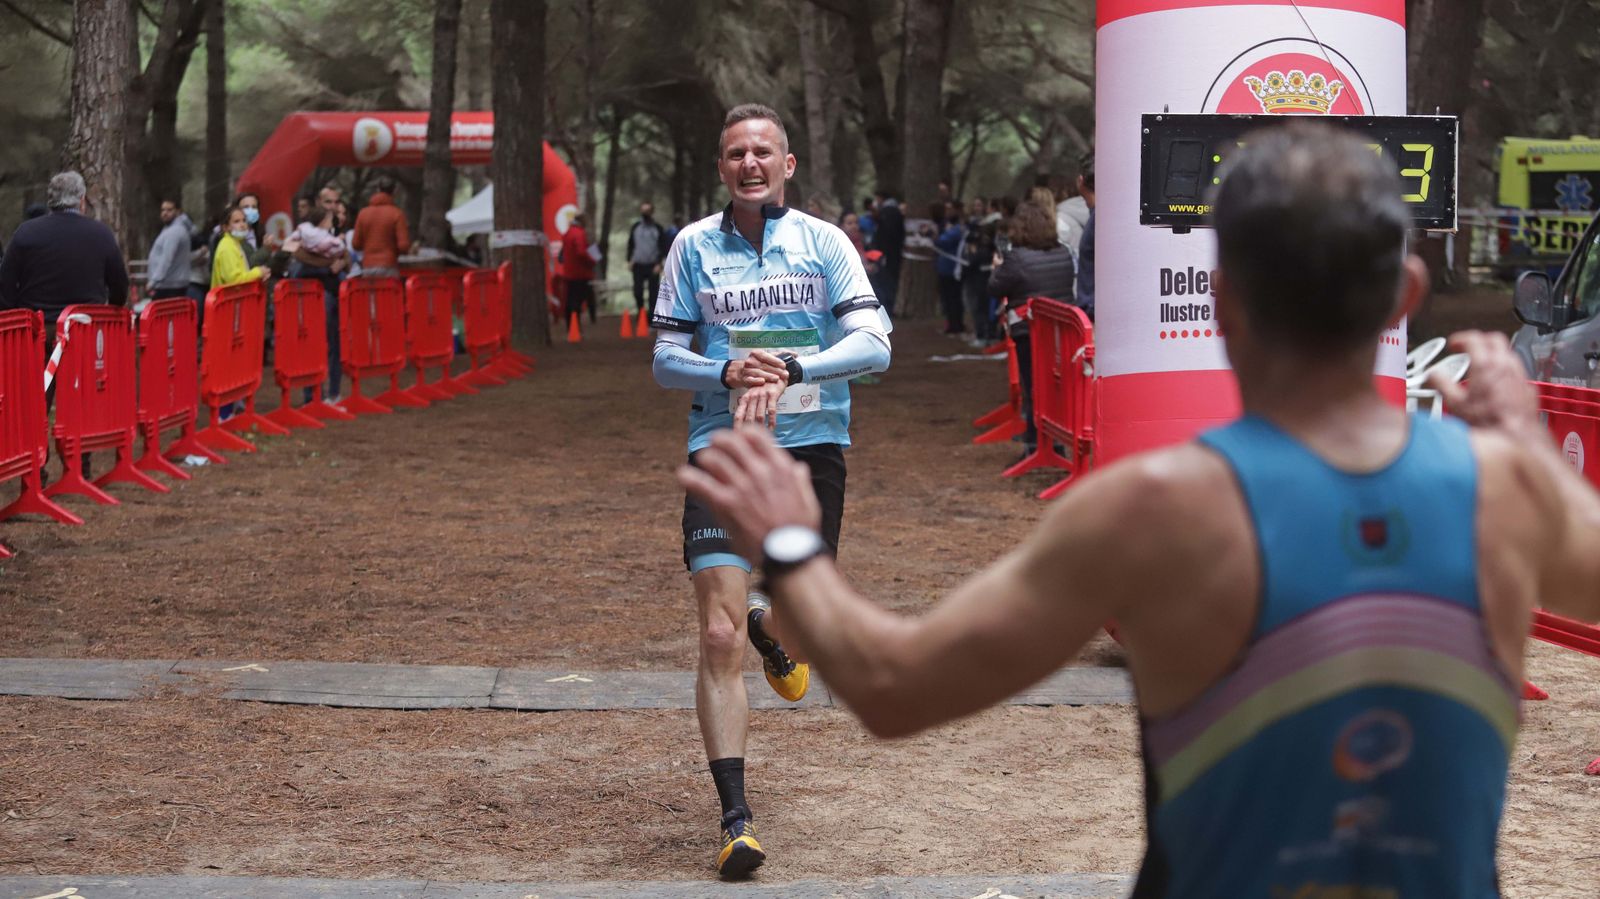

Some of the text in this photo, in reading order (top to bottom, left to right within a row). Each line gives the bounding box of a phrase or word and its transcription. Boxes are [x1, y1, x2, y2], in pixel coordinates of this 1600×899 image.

[710, 283, 815, 315] C.C.MANILVA
[1160, 302, 1210, 323] Ilustre
[811, 366, 873, 382] www.ccmanilva.com
